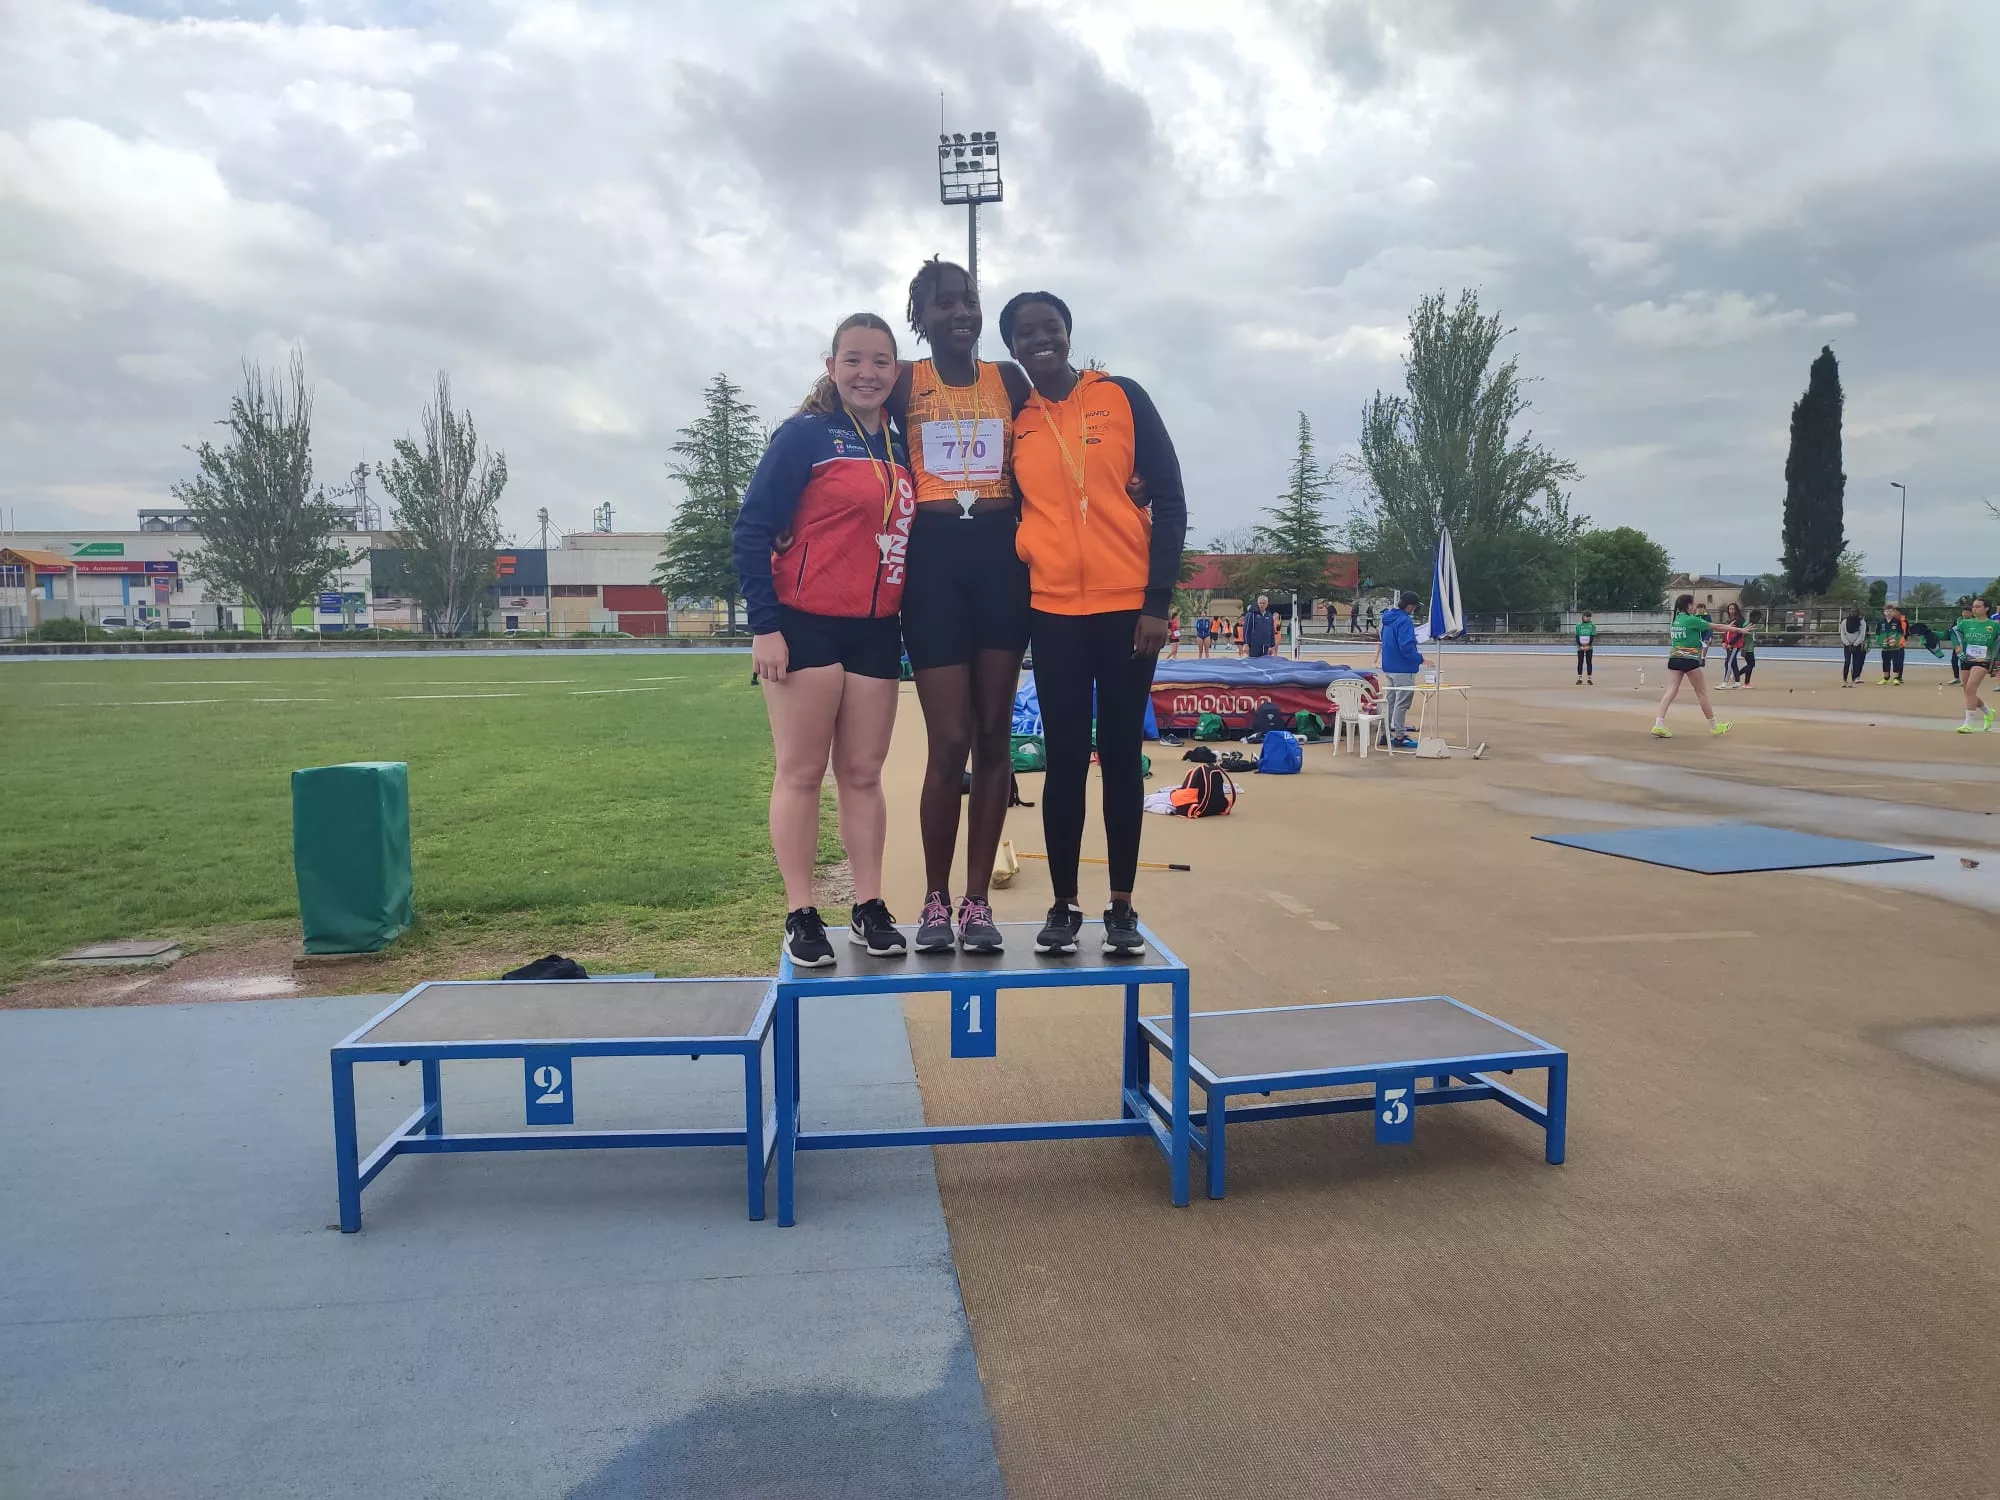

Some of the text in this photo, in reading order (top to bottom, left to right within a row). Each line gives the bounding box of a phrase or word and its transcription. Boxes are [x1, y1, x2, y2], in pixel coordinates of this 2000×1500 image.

[942, 440, 986, 459] 770
[886, 478, 914, 584] HINACO
[962, 995, 982, 1033] 1
[533, 1065, 564, 1104] 2
[1382, 1088, 1409, 1124] 3
